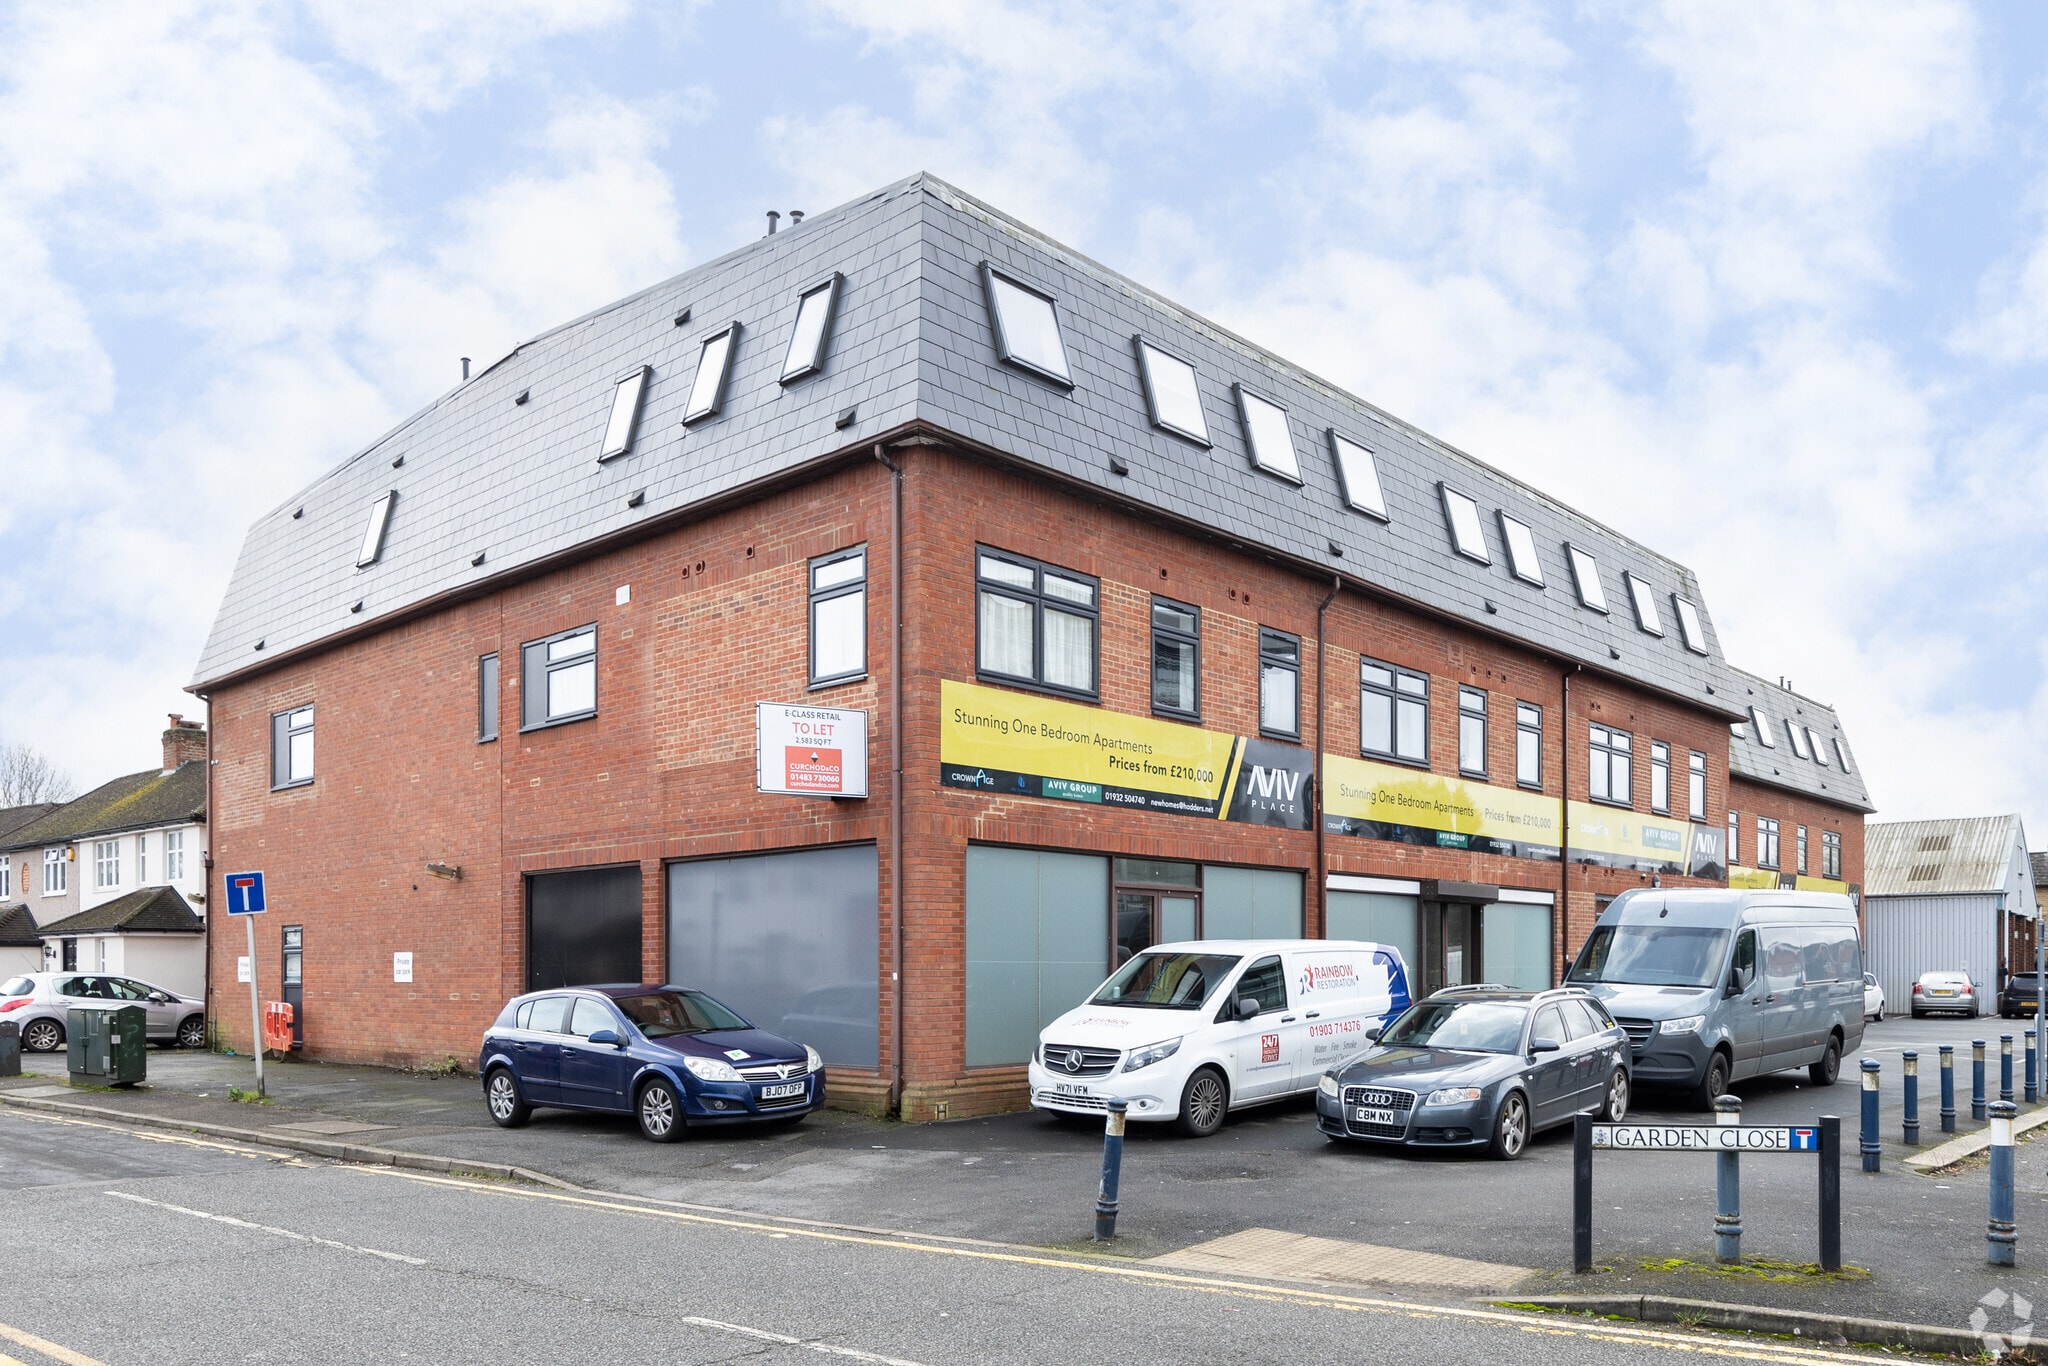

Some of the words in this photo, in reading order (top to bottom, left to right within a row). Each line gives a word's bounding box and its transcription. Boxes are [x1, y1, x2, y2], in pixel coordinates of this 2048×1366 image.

[785, 709, 815, 719] E-CLASS
[816, 711, 842, 721] RETAIL
[792, 721, 810, 735] TO
[813, 723, 835, 736] LET
[954, 708, 1009, 735] Stunning
[1012, 718, 1037, 736] One
[1041, 723, 1090, 745] Bedroom
[1093, 733, 1153, 755] Apartments
[814, 738, 822, 746] SQ
[1109, 755, 1141, 772] Prices
[1143, 760, 1167, 776] from
[1170, 765, 1214, 783] £210,000
[790, 773, 812, 782] 01483
[813, 774, 840, 783] 730060
[790, 780, 840, 789] curchodandco.com
[1247, 765, 1300, 801] AVIV
[1048, 780, 1068, 790] AVIV
[1069, 782, 1097, 794] GROUP
[1104, 792, 1124, 802] 01932
[1124, 794, 1146, 805] 504740
[1150, 798, 1214, 814] newhomes@hodders.net
[1251, 800, 1295, 814] PLACE
[1339, 783, 1377, 804] Stunning
[1378, 790, 1396, 805] One
[1397, 792, 1432, 810] Bedroom
[1433, 799, 1474, 817] Apartments
[1484, 807, 1505, 821] Prices
[1506, 809, 1522, 825] from
[1522, 813, 1552, 829] £210,000
[1450, 834, 1466, 842] GROUP
[1645, 828, 1659, 838] AVIV
[1660, 830, 1679, 841] GROUP
[1314, 964, 1353, 979] RAINBOW
[1316, 977, 1356, 990] RESTORATION
[1309, 1022, 1333, 1037] 01903
[1335, 1020, 1361, 1035] 714376
[1262, 1035, 1278, 1048] 24/7
[766, 1085, 787, 1097] BJ07
[788, 1083, 802, 1094] OFP
[1056, 1082, 1072, 1095] HV71
[1073, 1084, 1088, 1096] VFM
[1378, 1111, 1392, 1123] NX
[1615, 1128, 1709, 1148] GARDEN
[1719, 1129, 1787, 1149] CLOSE
